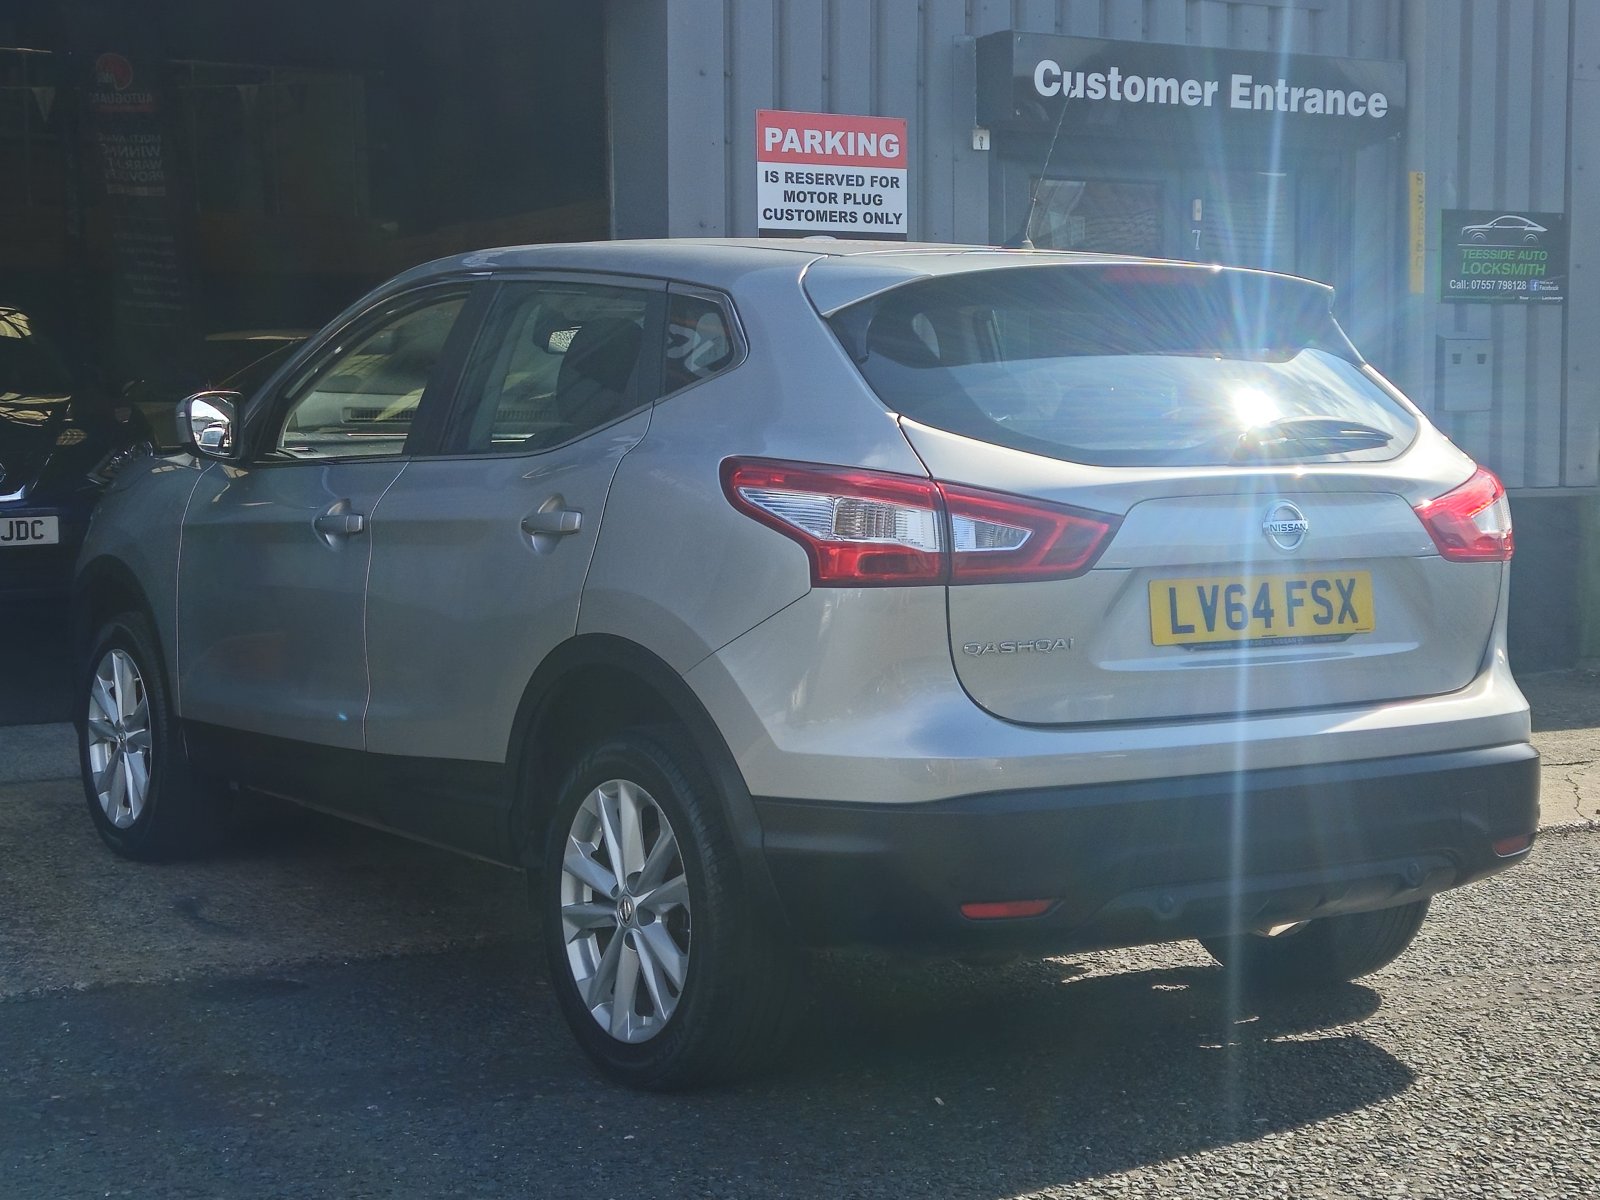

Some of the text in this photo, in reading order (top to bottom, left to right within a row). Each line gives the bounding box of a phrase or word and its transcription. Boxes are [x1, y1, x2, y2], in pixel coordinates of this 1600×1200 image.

[1034, 58, 1389, 118] Customer Entrance
[764, 127, 900, 158] PARKING
[765, 170, 900, 189] IS RESERVED FOR
[783, 190, 883, 206] MOTOR PLUG
[763, 208, 902, 225] CUSTOMERS ONLY
[1191, 229, 1202, 250] 7
[1462, 248, 1548, 261] TEESSIDE AUTO
[1461, 262, 1546, 276] LOCKSMITH
[1449, 280, 1527, 290] Call: 07557 798128
[0, 520, 44, 541] JDC
[1269, 523, 1307, 533] NISSAN
[1169, 578, 1359, 635] LV64 FSX
[962, 637, 1074, 657] QASHQAI
